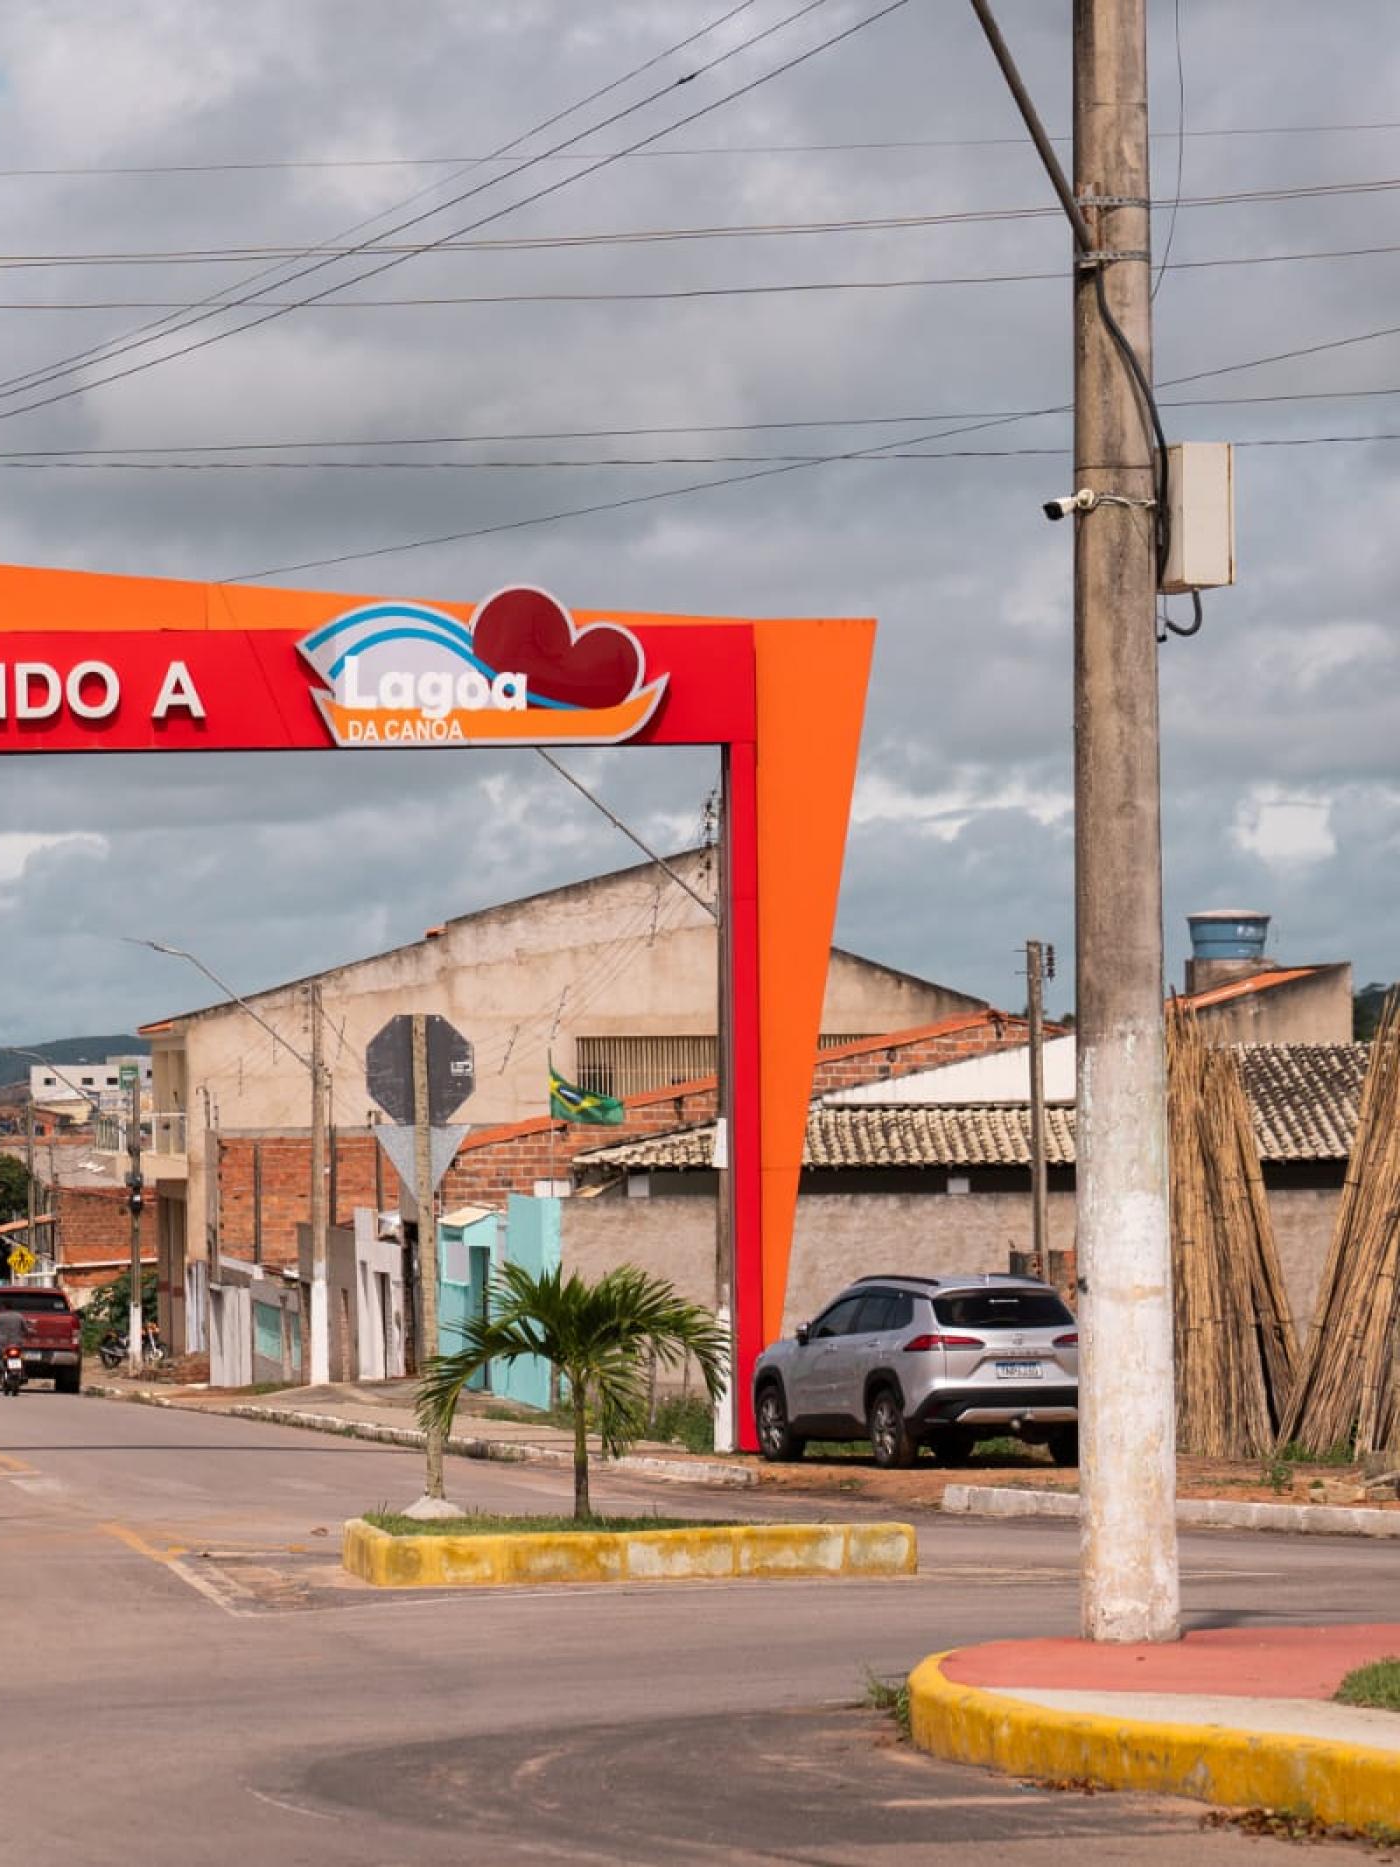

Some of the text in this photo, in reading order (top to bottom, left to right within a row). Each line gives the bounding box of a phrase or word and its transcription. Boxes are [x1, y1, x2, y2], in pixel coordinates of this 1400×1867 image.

[152, 660, 205, 718] A
[344, 655, 528, 719] Lagoa
[348, 718, 464, 741] DA CANOA
